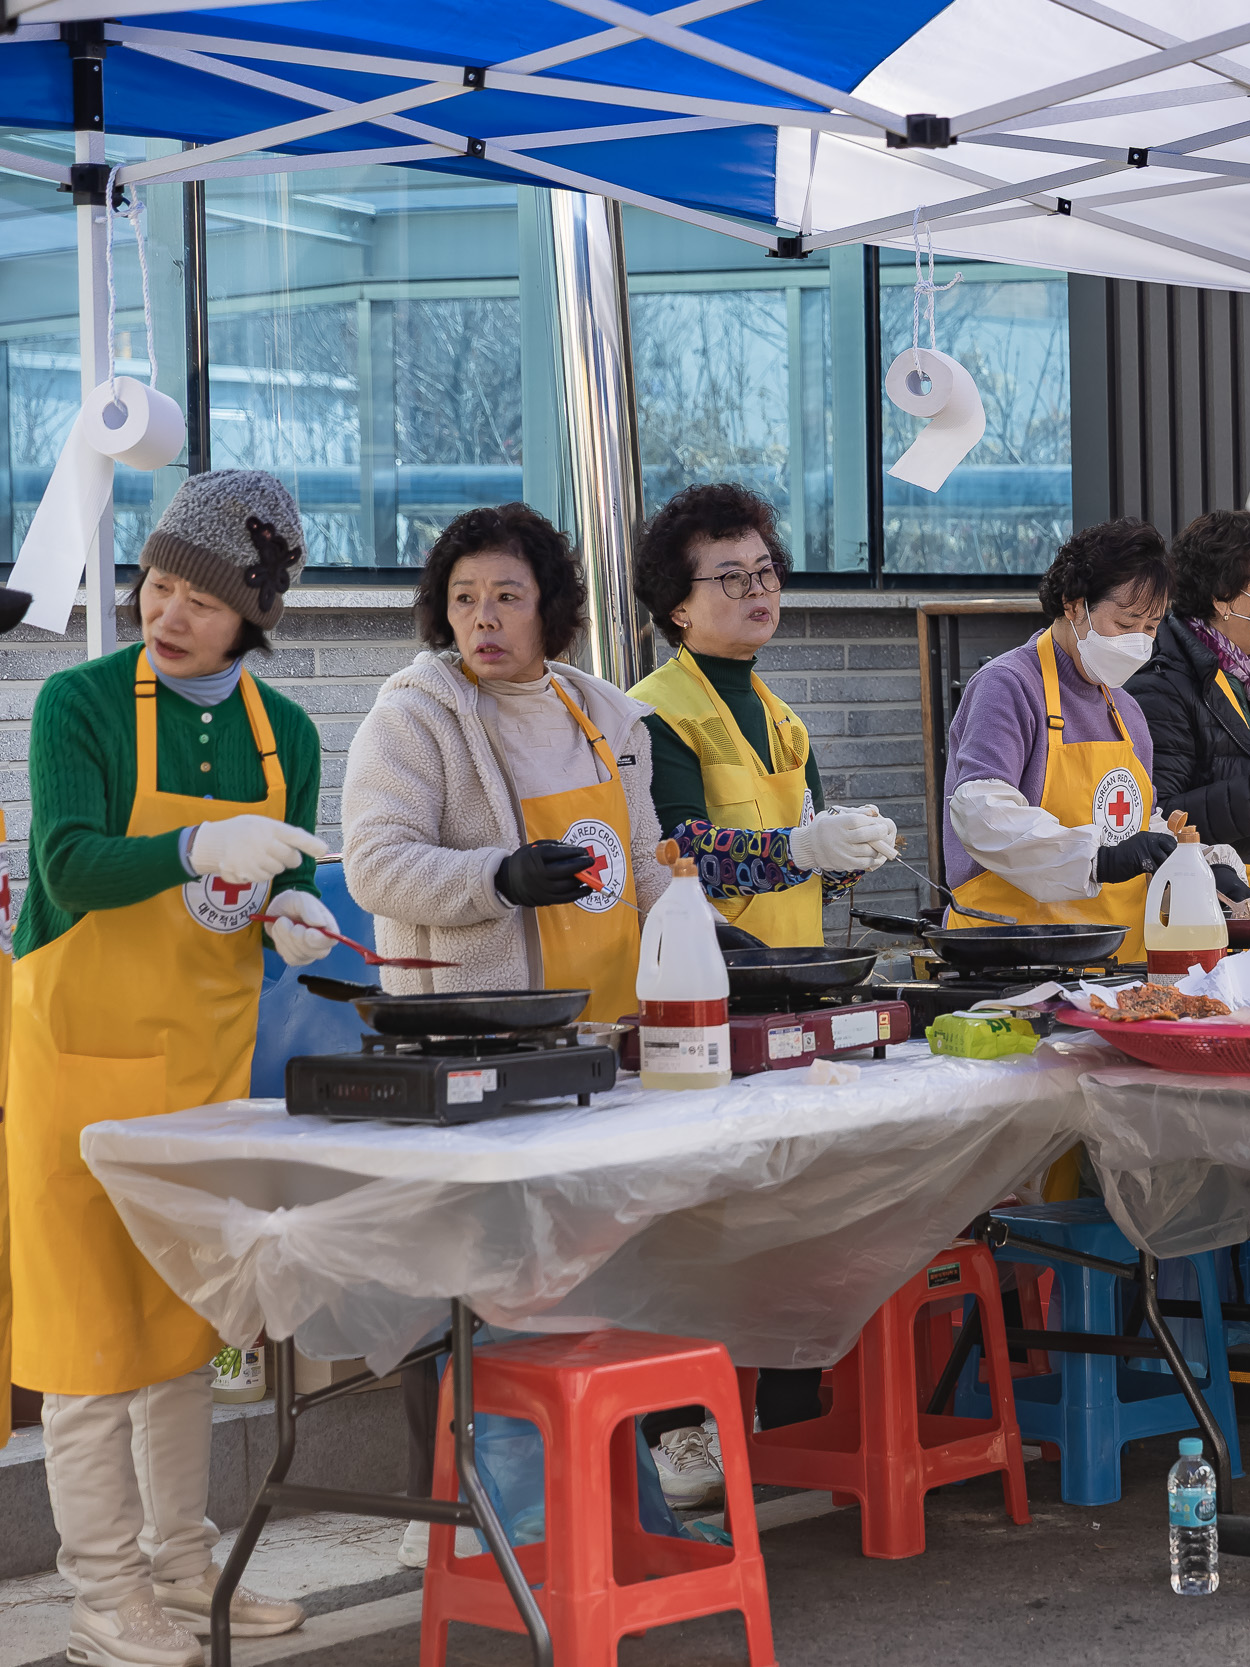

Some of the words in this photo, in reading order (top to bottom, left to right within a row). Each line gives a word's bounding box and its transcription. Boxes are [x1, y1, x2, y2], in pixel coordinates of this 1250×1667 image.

[1097, 776, 1116, 810] KOREAN
[1117, 774, 1128, 783] RED
[1127, 779, 1139, 808] CROSS
[577, 826, 596, 837] RED
[598, 829, 620, 858] CROSS
[198, 901, 257, 927] 대한적십자사
